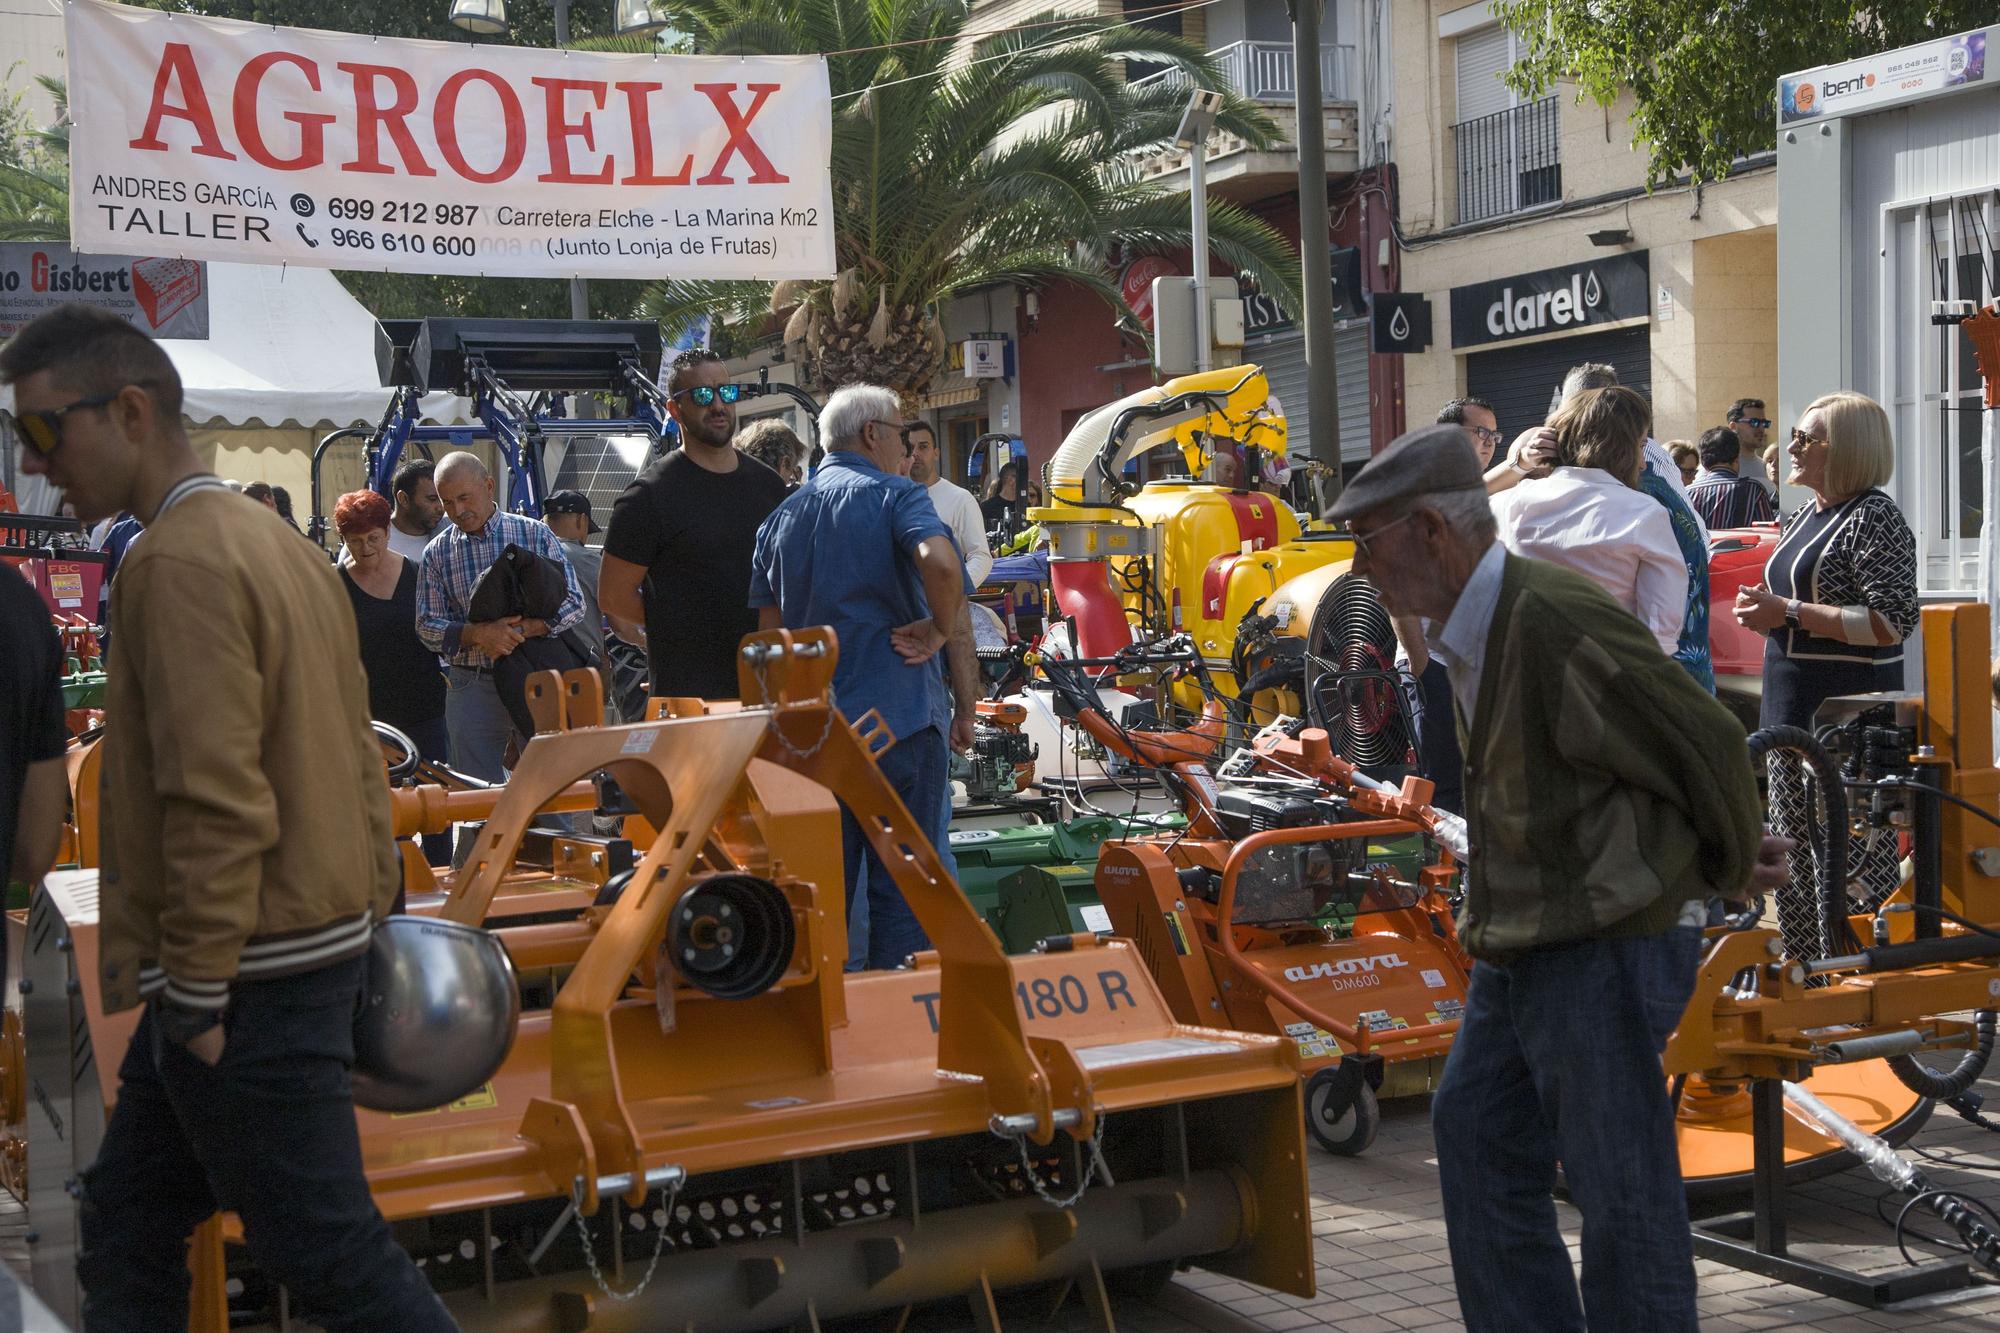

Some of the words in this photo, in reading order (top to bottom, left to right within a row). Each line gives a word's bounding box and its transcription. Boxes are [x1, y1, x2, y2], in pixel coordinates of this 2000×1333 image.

[129, 42, 789, 185] AGROELX
[92, 174, 187, 202] ANDRES
[194, 183, 277, 211] GARCÍA
[98, 204, 272, 243] TALLER
[328, 197, 374, 221] 699
[382, 201, 427, 224] 212
[435, 204, 479, 226] 987
[497, 206, 591, 228] Carretera
[599, 209, 654, 228] Elche
[675, 209, 700, 227] La
[706, 208, 774, 227] Marina
[780, 207, 818, 227] Km2
[331, 228, 375, 250] 966
[381, 233, 425, 253] 610
[432, 236, 476, 257] 600
[547, 237, 610, 260] (Junto
[617, 238, 673, 259] Lonja
[680, 237, 704, 255] de
[711, 236, 777, 259] Frutas)
[31, 251, 130, 293] Gisbert
[1486, 273, 1585, 336] clarel
[48, 563, 81, 574] FBC
[1284, 953, 1409, 983] anova
[1332, 974, 1380, 992] DM600
[912, 992, 941, 1034] T
[1017, 974, 1089, 1020] 180
[1097, 970, 1137, 1011] R
